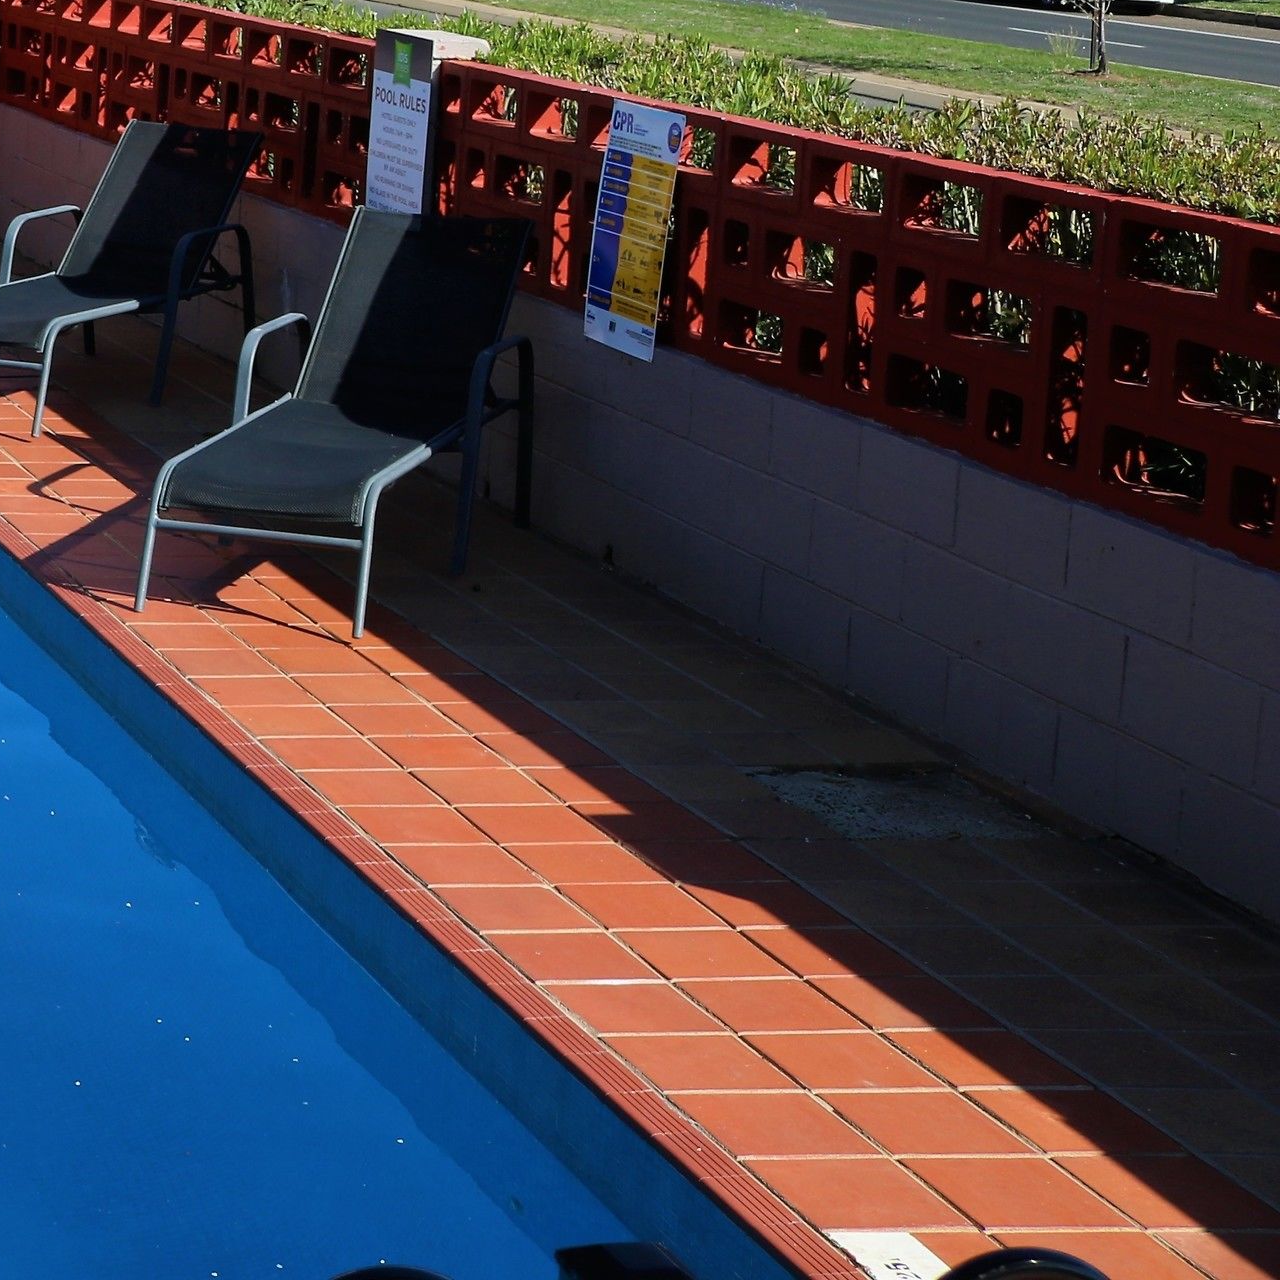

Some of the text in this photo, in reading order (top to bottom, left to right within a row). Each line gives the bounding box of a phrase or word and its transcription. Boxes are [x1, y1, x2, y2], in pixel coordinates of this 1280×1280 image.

[375, 86, 426, 114] POOL RULES
[613, 109, 634, 134] CPR
